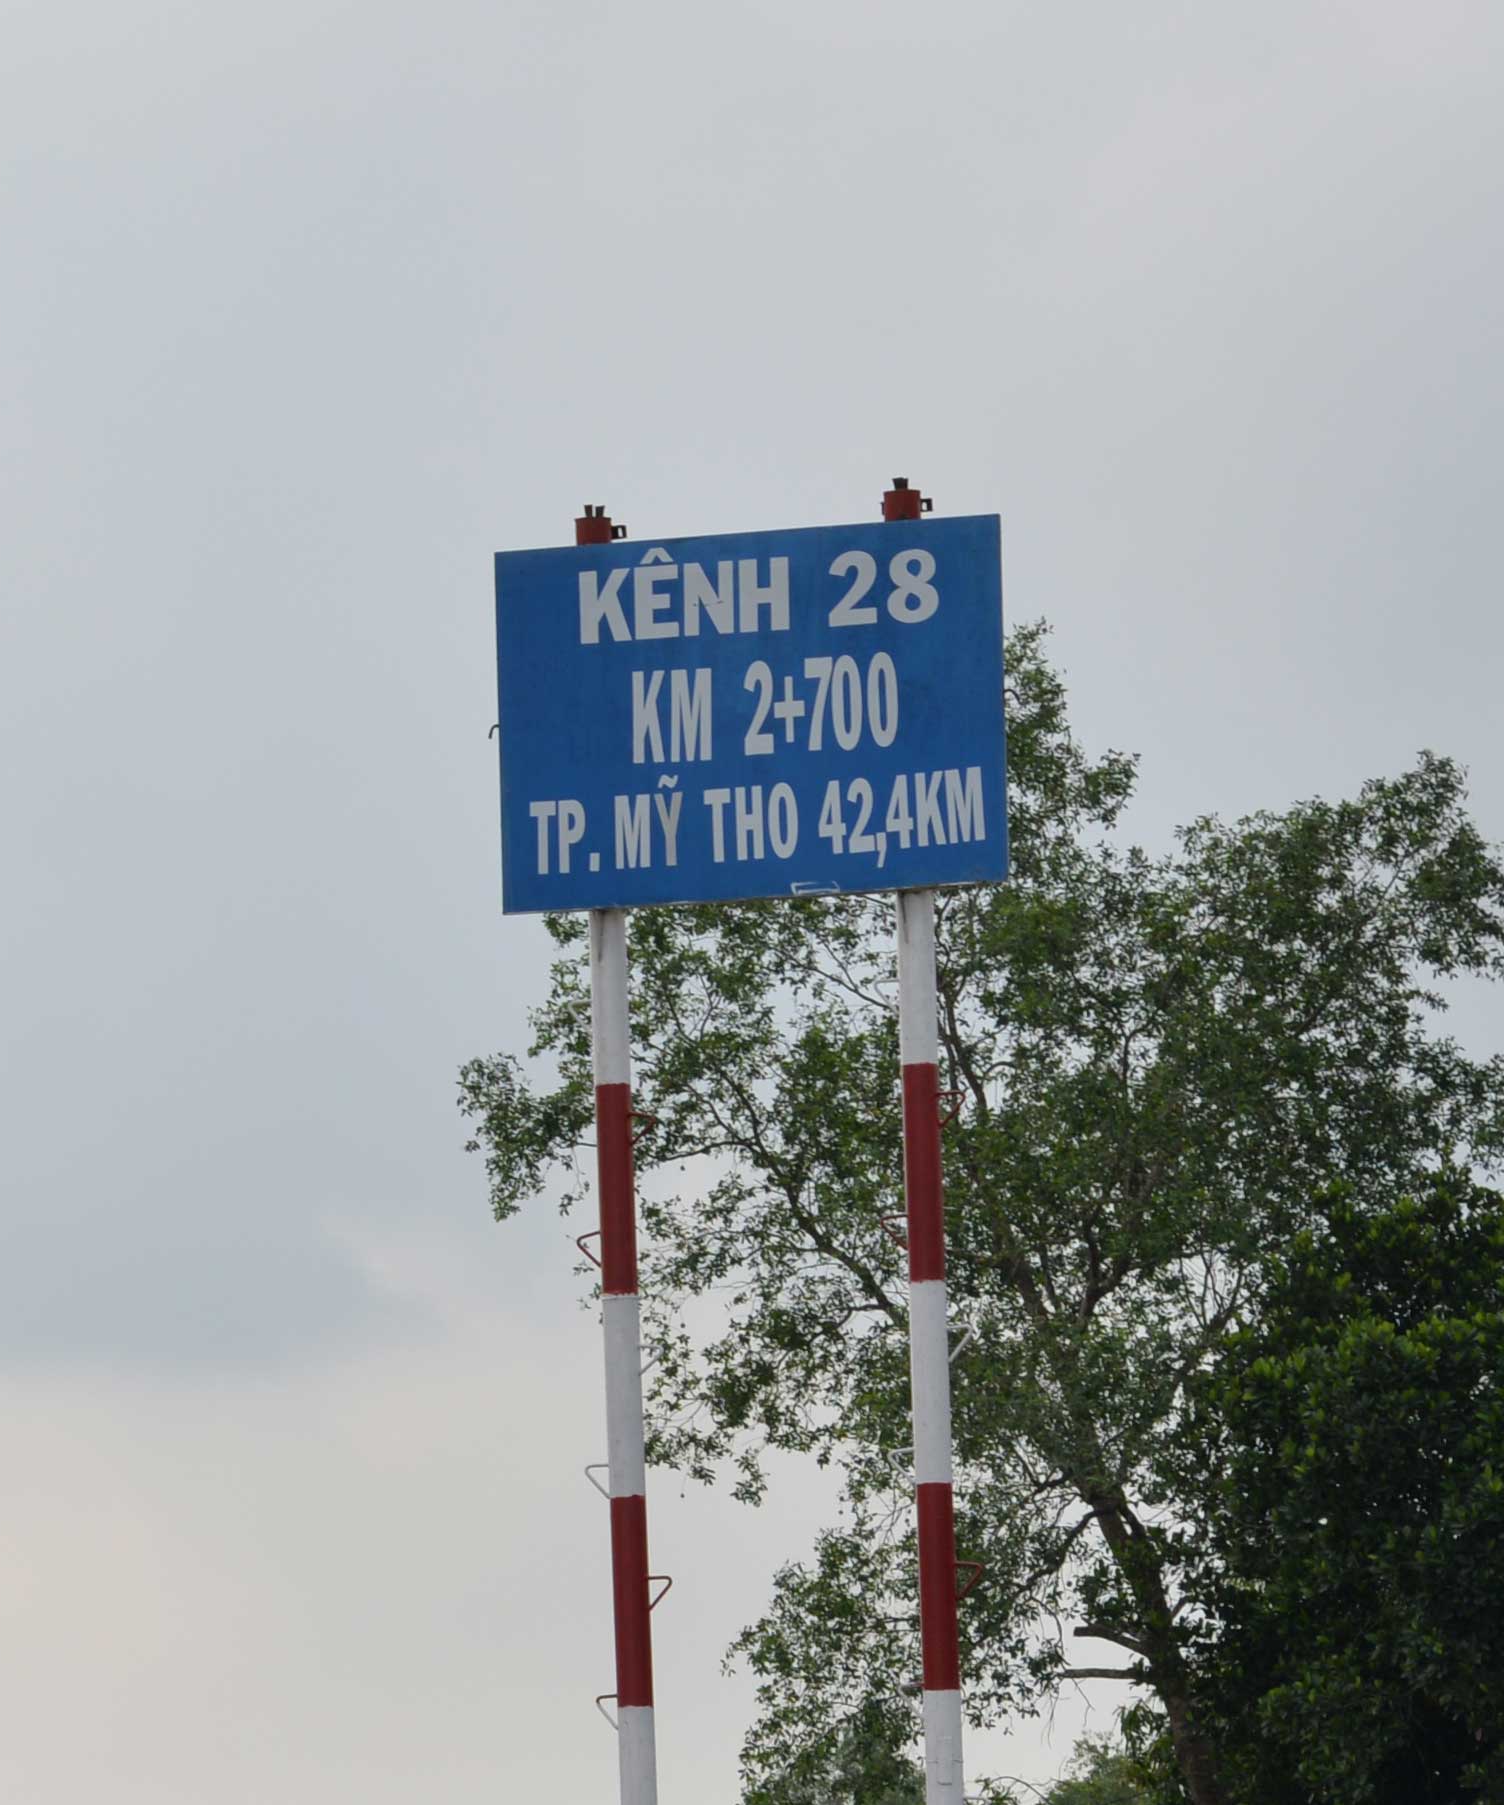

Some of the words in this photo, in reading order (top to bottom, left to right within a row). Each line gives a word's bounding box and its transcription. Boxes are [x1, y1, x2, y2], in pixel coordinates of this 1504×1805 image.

[578, 547, 791, 645] KÊNH
[828, 548, 940, 628] 28
[632, 668, 713, 764] KM
[743, 651, 899, 757] 2+700
[529, 799, 601, 875] TP.
[614, 774, 684, 870] MỸ
[703, 783, 799, 864] THO
[818, 766, 987, 869] 42,4KM
